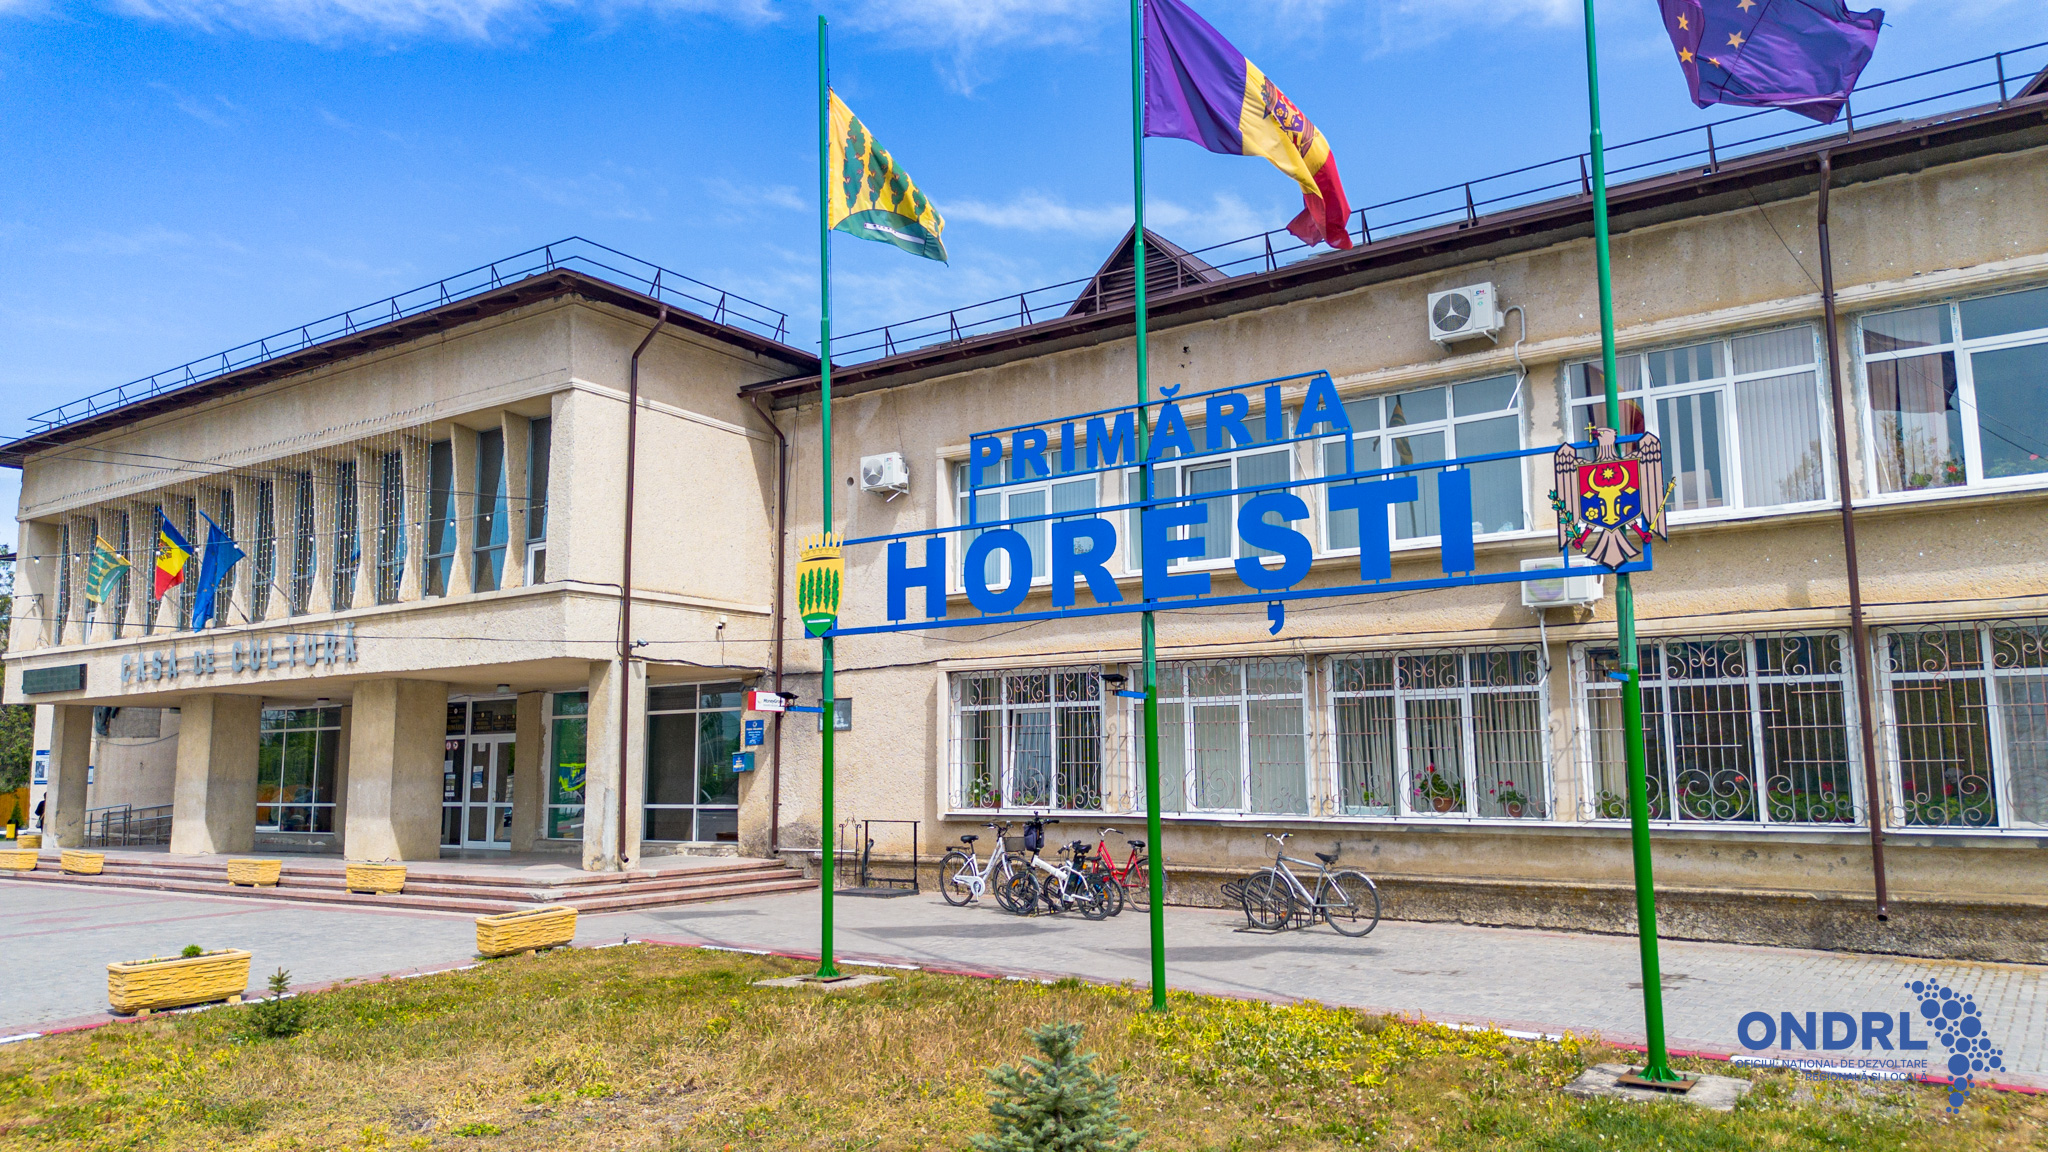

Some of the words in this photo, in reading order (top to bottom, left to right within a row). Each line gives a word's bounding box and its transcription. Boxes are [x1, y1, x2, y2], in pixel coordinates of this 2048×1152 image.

[970, 377, 1347, 486] PRIMĂRIA
[886, 469, 1476, 634] HOREȘTI
[121, 649, 178, 682] CASA
[193, 650, 215, 676] DE
[231, 621, 357, 673] CULTURĂ
